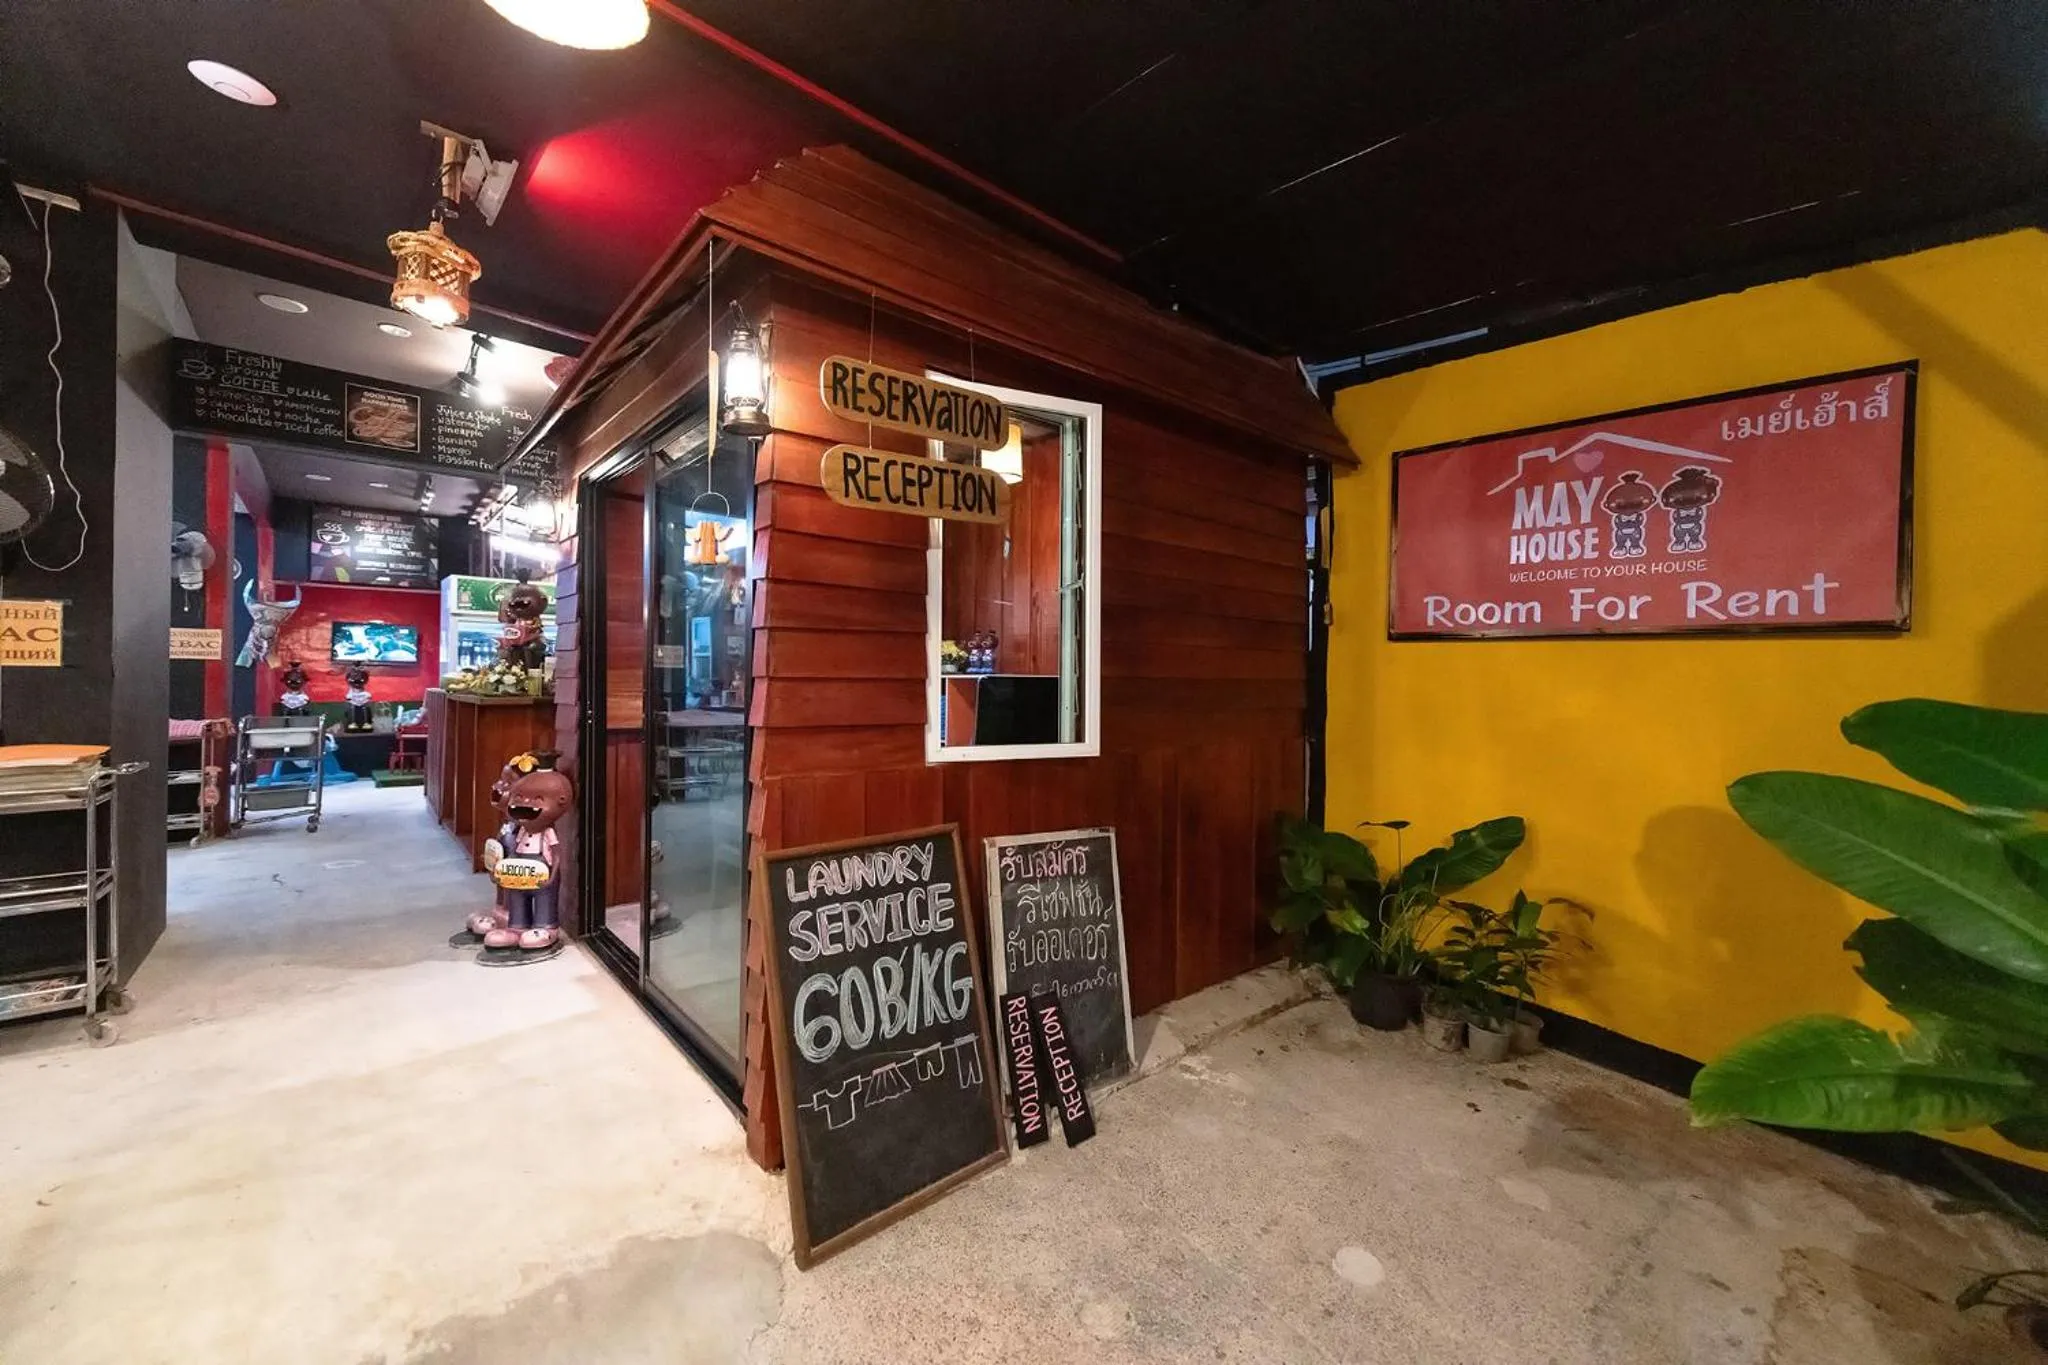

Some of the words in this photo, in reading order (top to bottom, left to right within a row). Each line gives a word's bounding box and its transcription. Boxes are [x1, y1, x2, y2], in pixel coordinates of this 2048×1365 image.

[220, 375, 280, 393] COFFEE
[225, 349, 283, 373] Freshly
[843, 451, 996, 517] RECEPTION
[1512, 476, 1604, 529] MAY
[1509, 527, 1599, 565] HOUSE
[1509, 567, 1577, 584] WELCOME
[1582, 566, 1601, 580] TO
[1603, 563, 1647, 577] YOUR
[1651, 558, 1708, 575] HOUSE
[1423, 595, 1542, 628] Room
[1569, 587, 1653, 624] For
[1690, 572, 1840, 622] Rent
[0, 626, 60, 643] АС
[785, 842, 934, 903] LAUNDRY
[788, 882, 955, 963] SERVICE
[1007, 995, 1042, 1134] RESERVATION
[1038, 1005, 1086, 1122] RECEPTION
